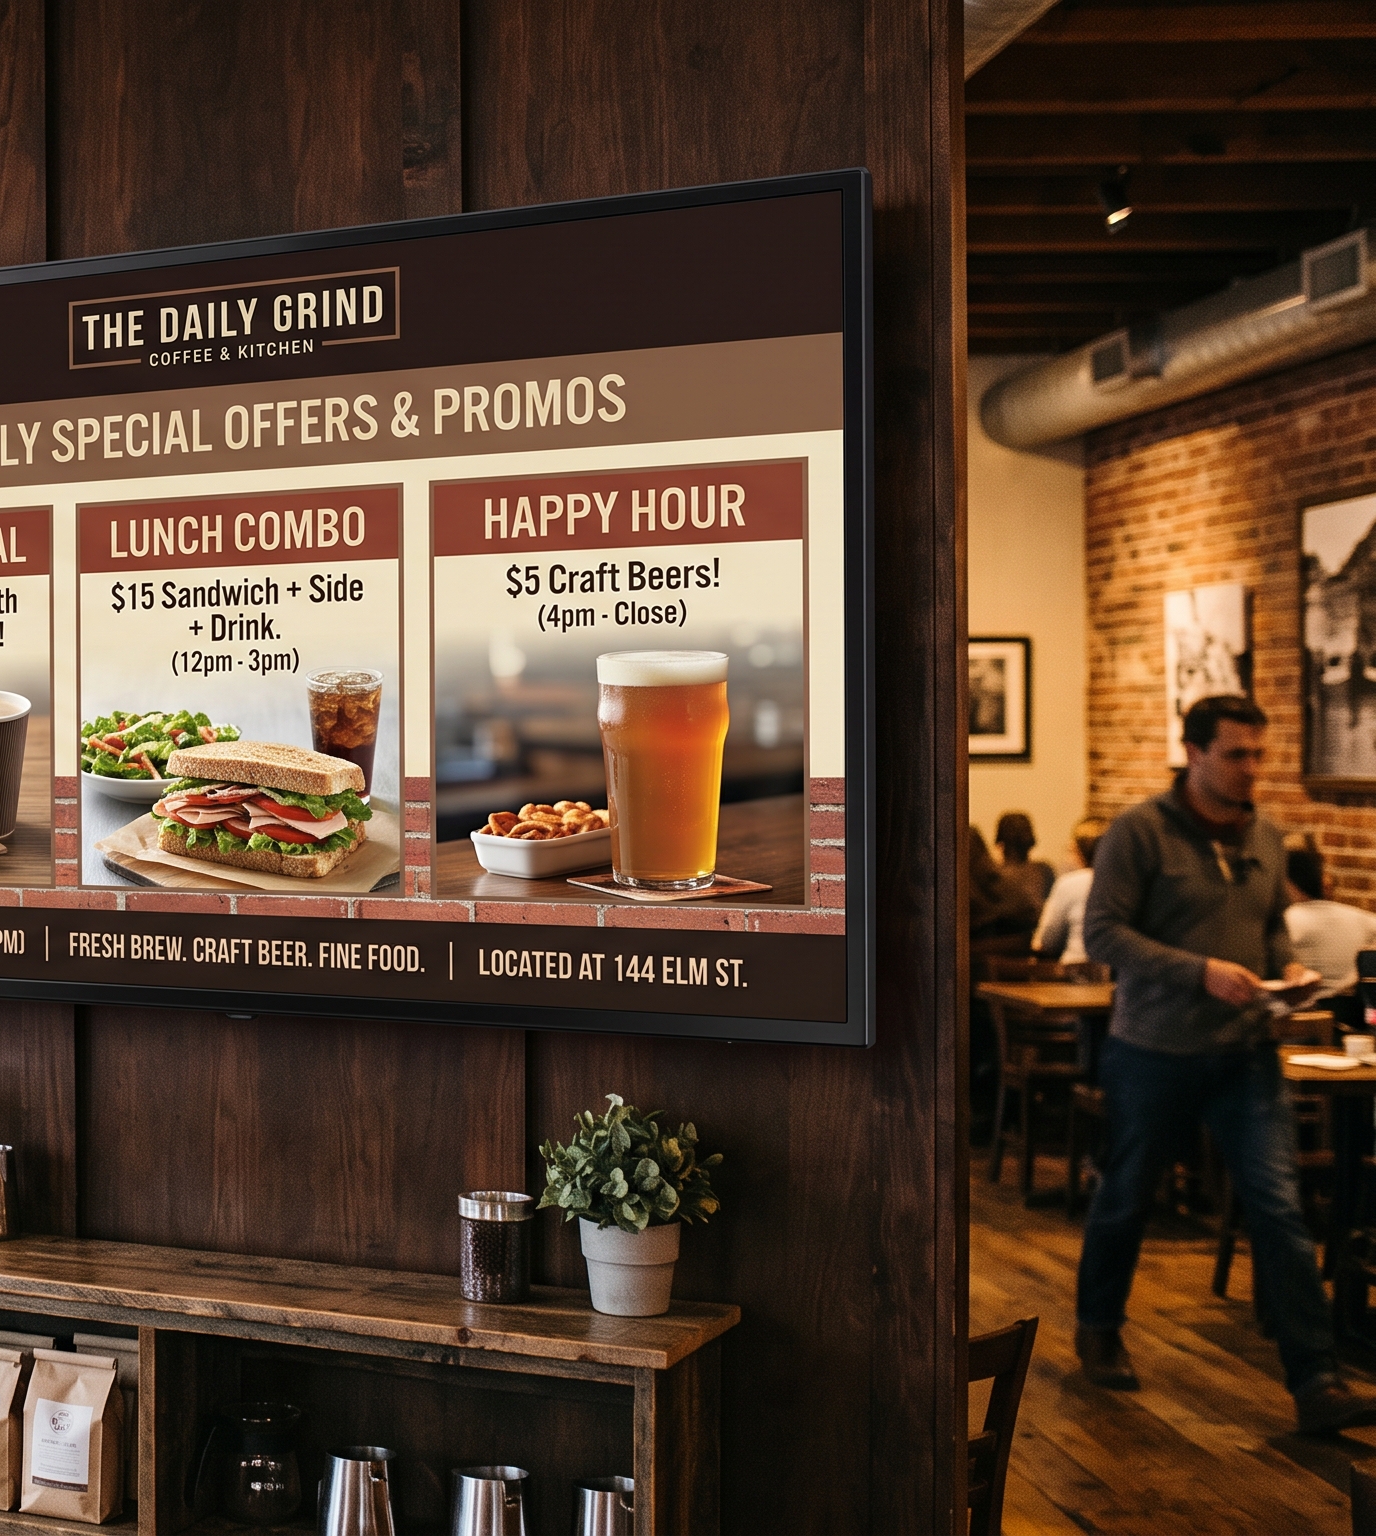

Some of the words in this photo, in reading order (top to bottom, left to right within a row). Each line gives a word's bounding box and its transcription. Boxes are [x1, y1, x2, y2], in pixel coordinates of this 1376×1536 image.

[82, 309, 144, 351] THE
[160, 297, 258, 344] DAILY
[273, 285, 383, 332] GRIND
[149, 348, 213, 367] COFFEE
[219, 346, 231, 361] &
[238, 338, 313, 359] KITCHEN
[51, 408, 213, 463] SPECIAL
[224, 394, 379, 450] OFFERS
[390, 391, 420, 438] &
[434, 373, 626, 435] PROMOS
[110, 514, 223, 558] LUNCH
[234, 505, 365, 552] COMBO
[484, 490, 619, 540] HAPPY
[631, 483, 746, 532] HOUR
[111, 581, 155, 614] $15
[161, 576, 279, 610] Sandwich
[286, 581, 302, 598] +
[308, 573, 364, 603] Side
[506, 563, 540, 599] $5
[549, 561, 621, 595] Craft
[628, 557, 720, 591] Beers!
[188, 620, 204, 636] +
[211, 612, 281, 642] Drink.
[538, 603, 595, 634] (4pm
[614, 598, 687, 628] Close)
[171, 650, 232, 678] (12pm
[248, 647, 300, 676] 3pm)
[69, 932, 125, 959] FRESH
[130, 934, 187, 962] BREW.
[193, 937, 253, 965] CRAFT
[258, 939, 313, 968] BEER.
[319, 942, 362, 970] FINE
[368, 944, 425, 973] FOOD.
[479, 948, 572, 979] LOCATED
[578, 953, 606, 981] AT
[614, 954, 656, 983] 144
[662, 956, 708, 986] ELM
[715, 958, 748, 988] ST.
